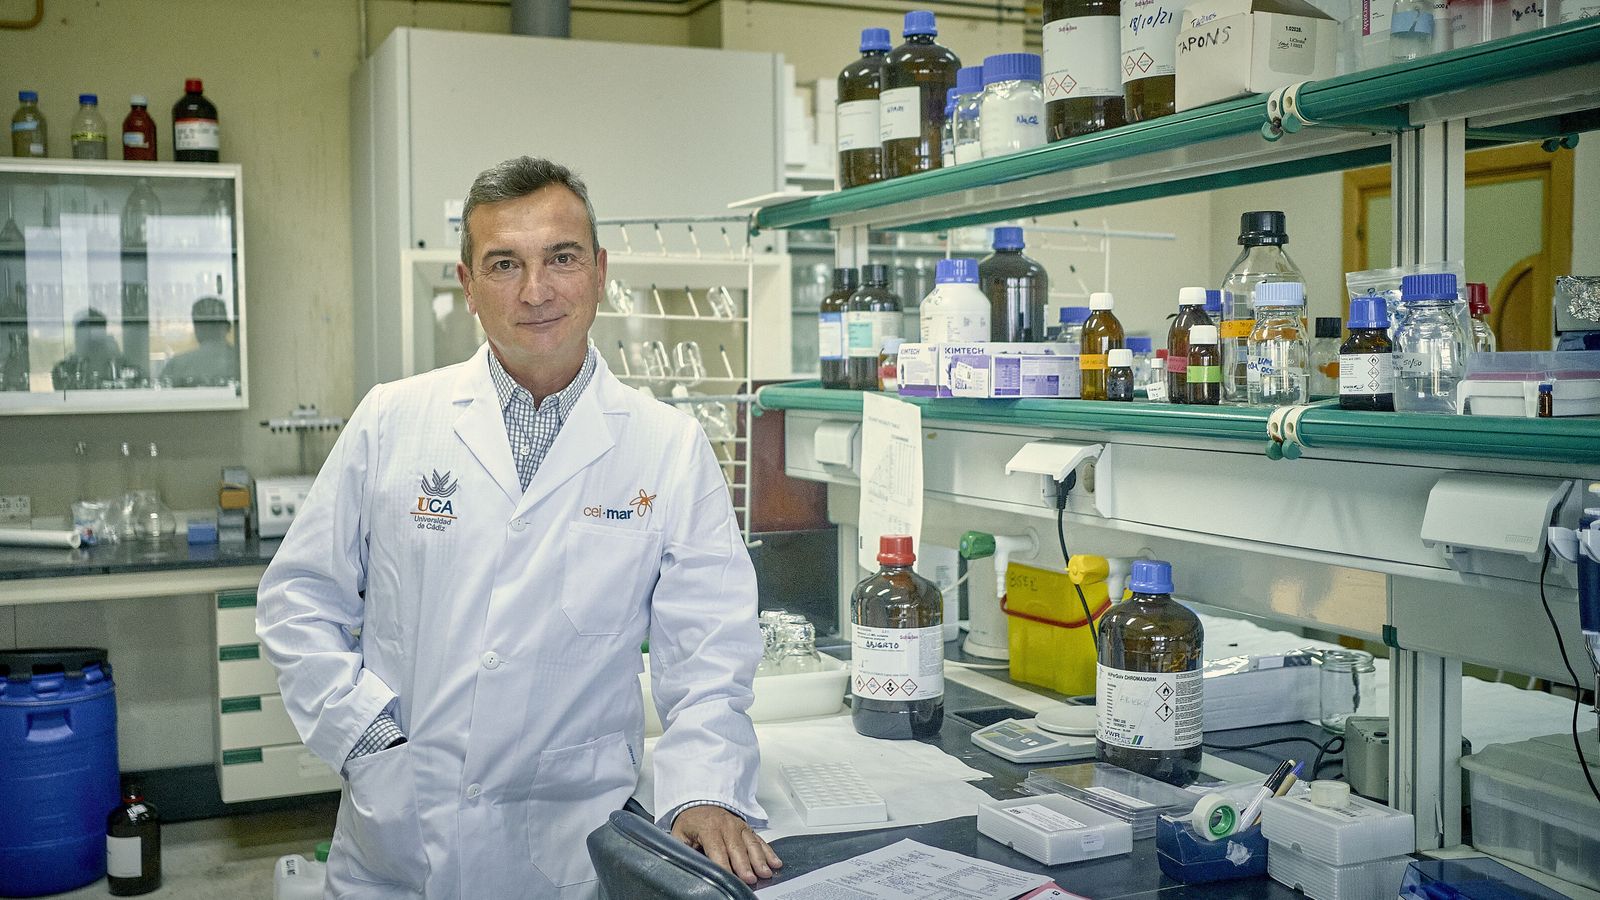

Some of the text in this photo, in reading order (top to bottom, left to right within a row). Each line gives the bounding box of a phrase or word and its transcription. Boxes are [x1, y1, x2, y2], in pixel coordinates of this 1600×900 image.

[1178, 26, 1231, 56] TAPONS
[945, 347, 984, 355] KIMTECH
[1403, 358, 1422, 368] 50/50
[418, 496, 453, 515] UCA
[414, 515, 452, 525] Universidad
[426, 522, 446, 532] Cádiz
[1124, 674, 1157, 682] CHROMANORM
[1104, 729, 1120, 738] VWR
